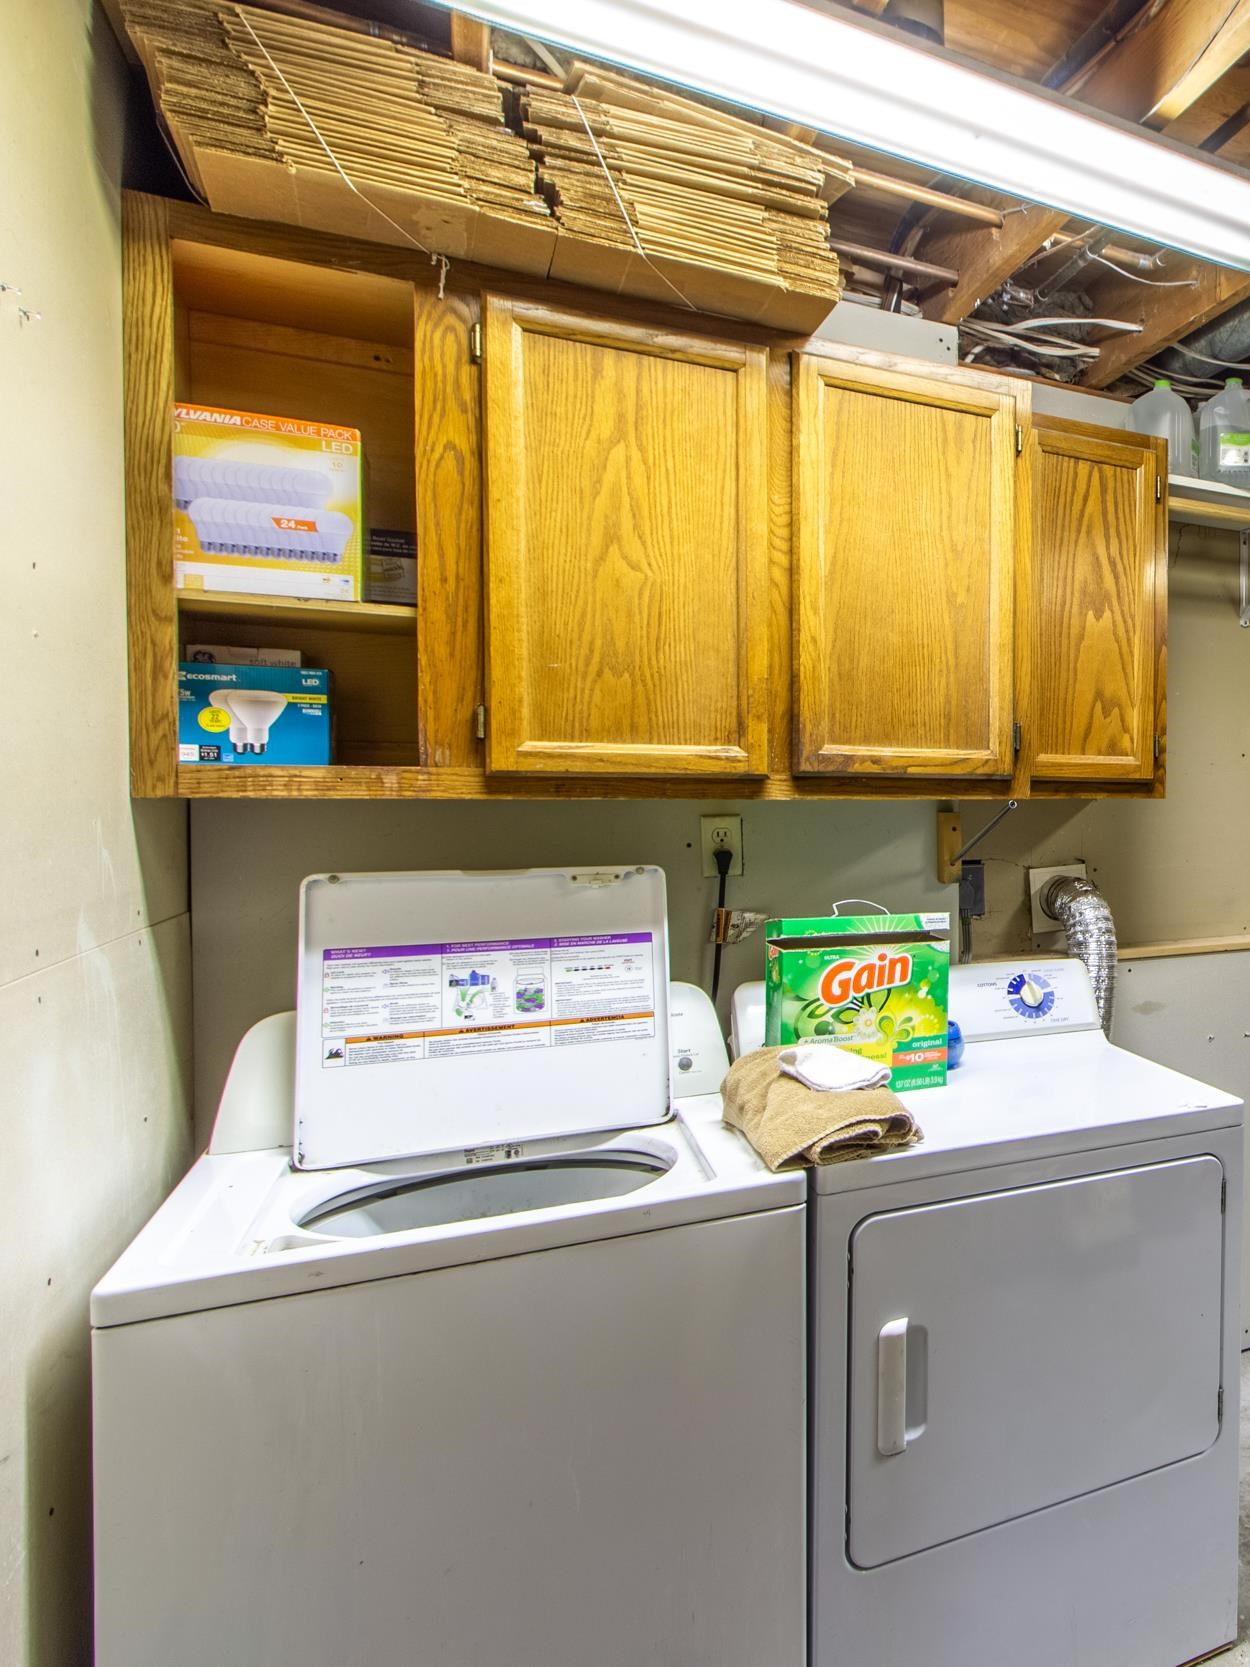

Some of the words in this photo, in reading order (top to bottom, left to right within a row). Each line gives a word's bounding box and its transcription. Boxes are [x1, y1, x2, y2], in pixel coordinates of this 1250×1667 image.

[174, 407, 241, 425] YLVANIA
[242, 417, 275, 430] CASE
[279, 422, 317, 436] VALUE
[320, 429, 353, 442] PACK
[322, 440, 353, 454] LED
[281, 519, 295, 529] 24
[187, 673, 237, 682] ecosmart
[302, 678, 319, 686] LED
[820, 951, 911, 1006] Gain
[586, 1014, 625, 1023] ADVERTENCIA
[465, 1024, 516, 1033] AVERTISSEMENT
[912, 1038, 943, 1049] original
